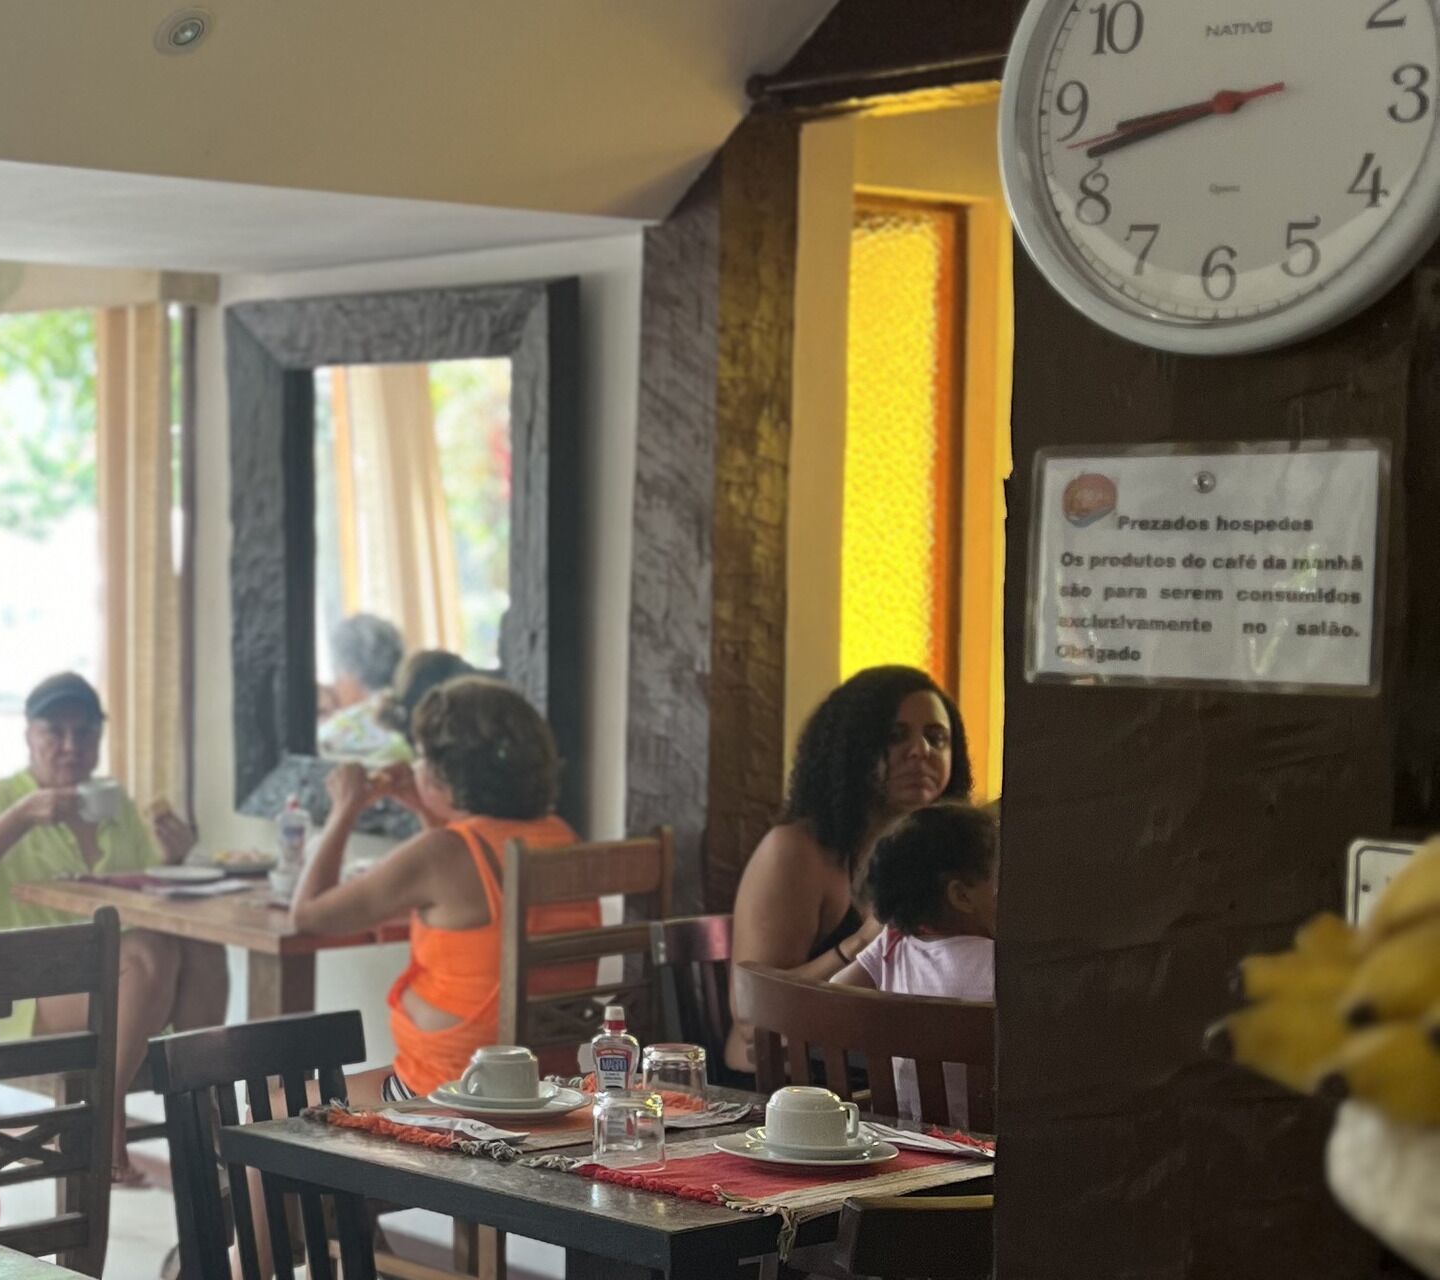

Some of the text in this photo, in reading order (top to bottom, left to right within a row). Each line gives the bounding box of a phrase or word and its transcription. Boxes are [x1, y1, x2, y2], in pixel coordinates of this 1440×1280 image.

[1089, 0, 1145, 55] 10
[1056, 80, 1089, 143] 9
[1387, 63, 1430, 123] 3
[1075, 159, 1112, 225] 8
[1347, 152, 1389, 209] 4
[1124, 223, 1160, 276] 7
[1201, 245, 1238, 302] 6
[1281, 215, 1322, 278] 5
[1118, 515, 1210, 531] Prezados
[1061, 551, 1363, 570] Os produtos do café da manhã
[1060, 583, 1362, 604] são para serem consumidos
[1058, 614, 1360, 637] exclusivamente no salão.
[1055, 644, 1142, 663] Obrigado
